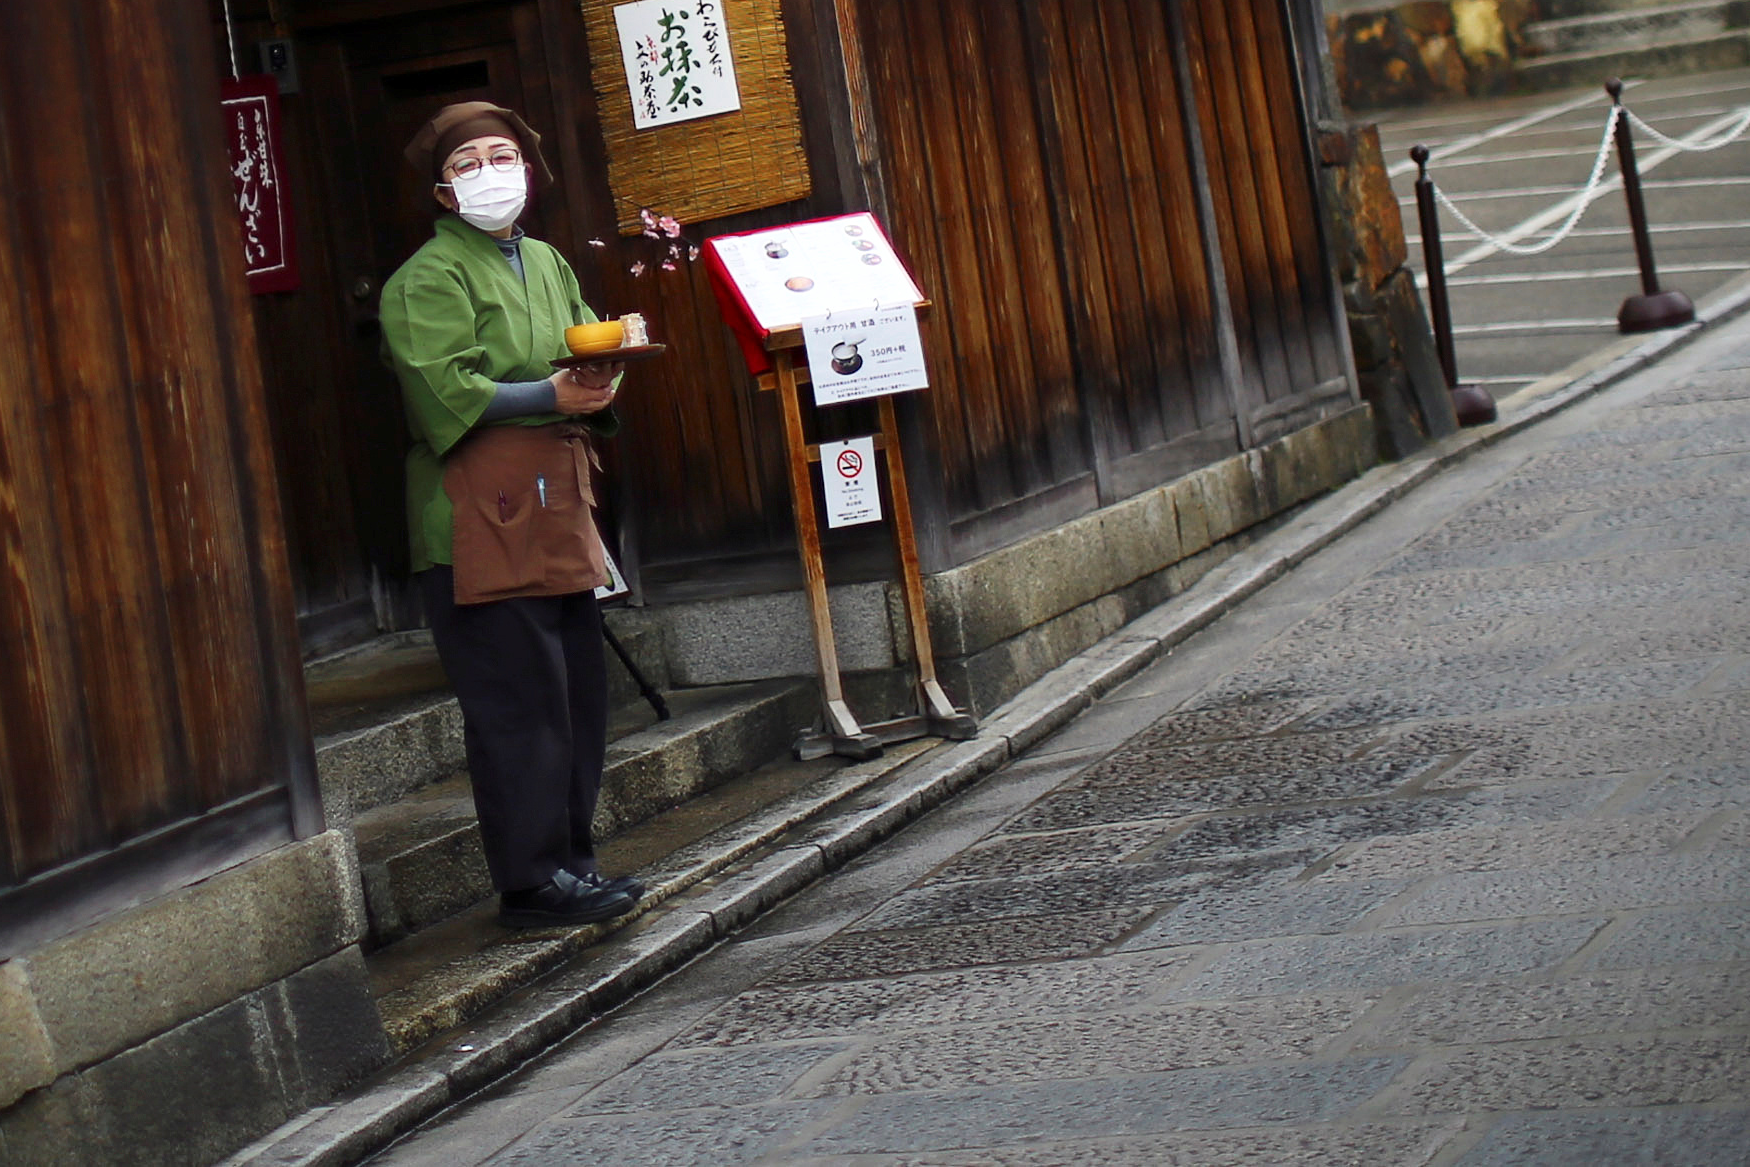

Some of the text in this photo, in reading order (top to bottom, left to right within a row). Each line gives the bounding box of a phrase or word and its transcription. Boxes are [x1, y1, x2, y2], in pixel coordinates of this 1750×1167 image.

[657, 7, 703, 112] お抹茶
[813, 315, 907, 334] テイクアウト用 甘酒 ございます。
